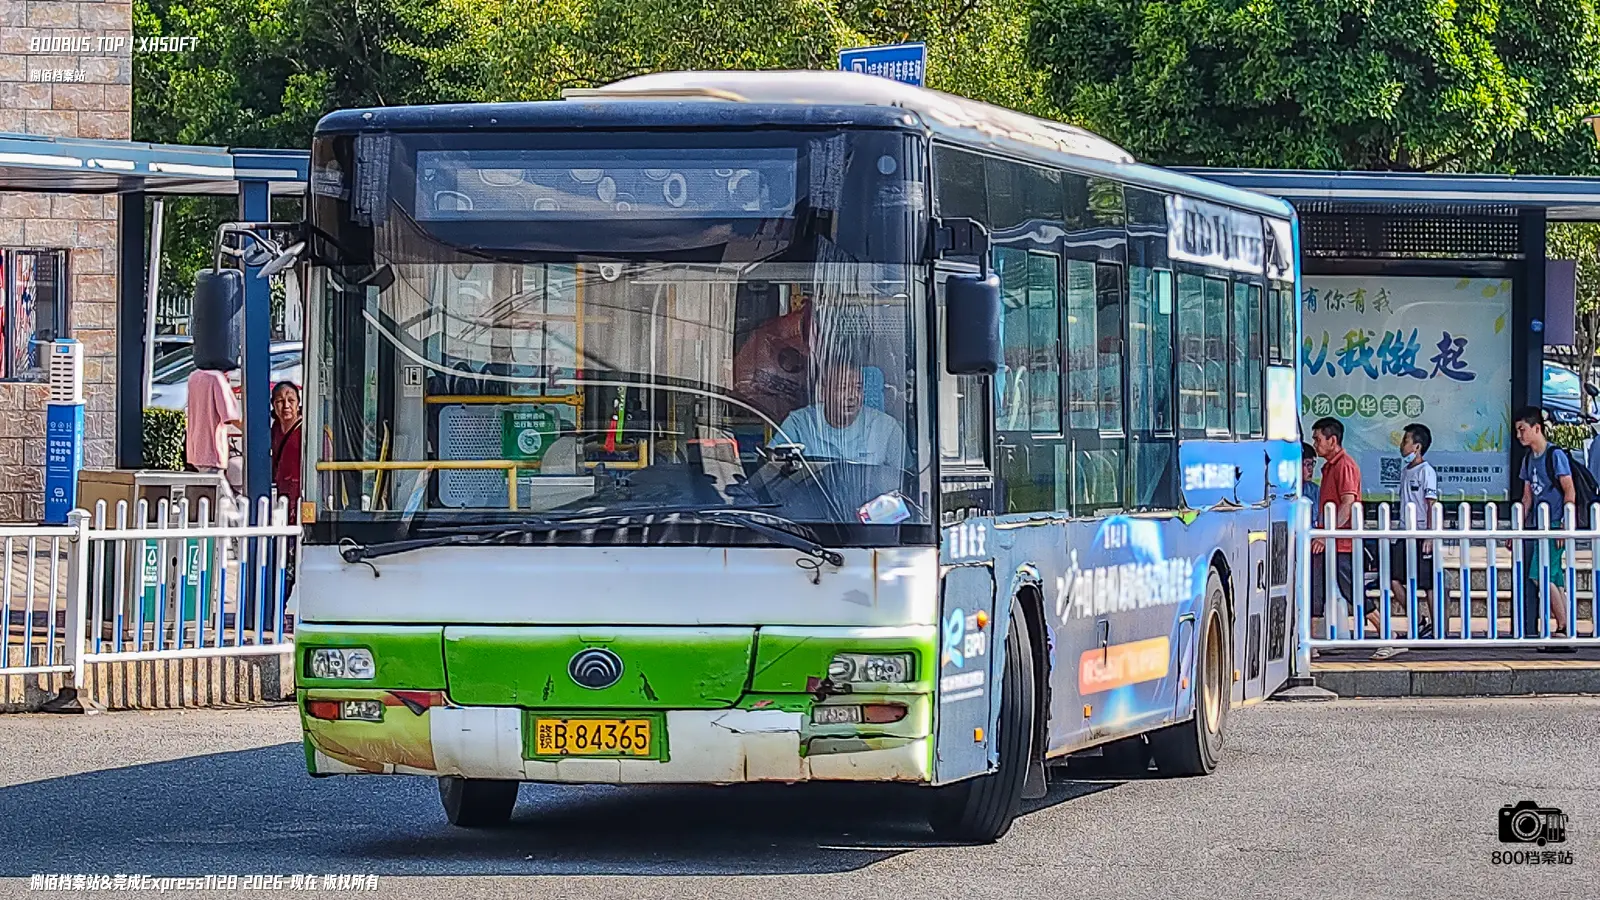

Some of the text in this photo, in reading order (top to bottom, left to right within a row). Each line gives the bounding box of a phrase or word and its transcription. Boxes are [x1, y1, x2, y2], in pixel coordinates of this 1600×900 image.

[1302, 287, 1394, 314] 有你有我
[1302, 328, 1477, 381] 从我做起
